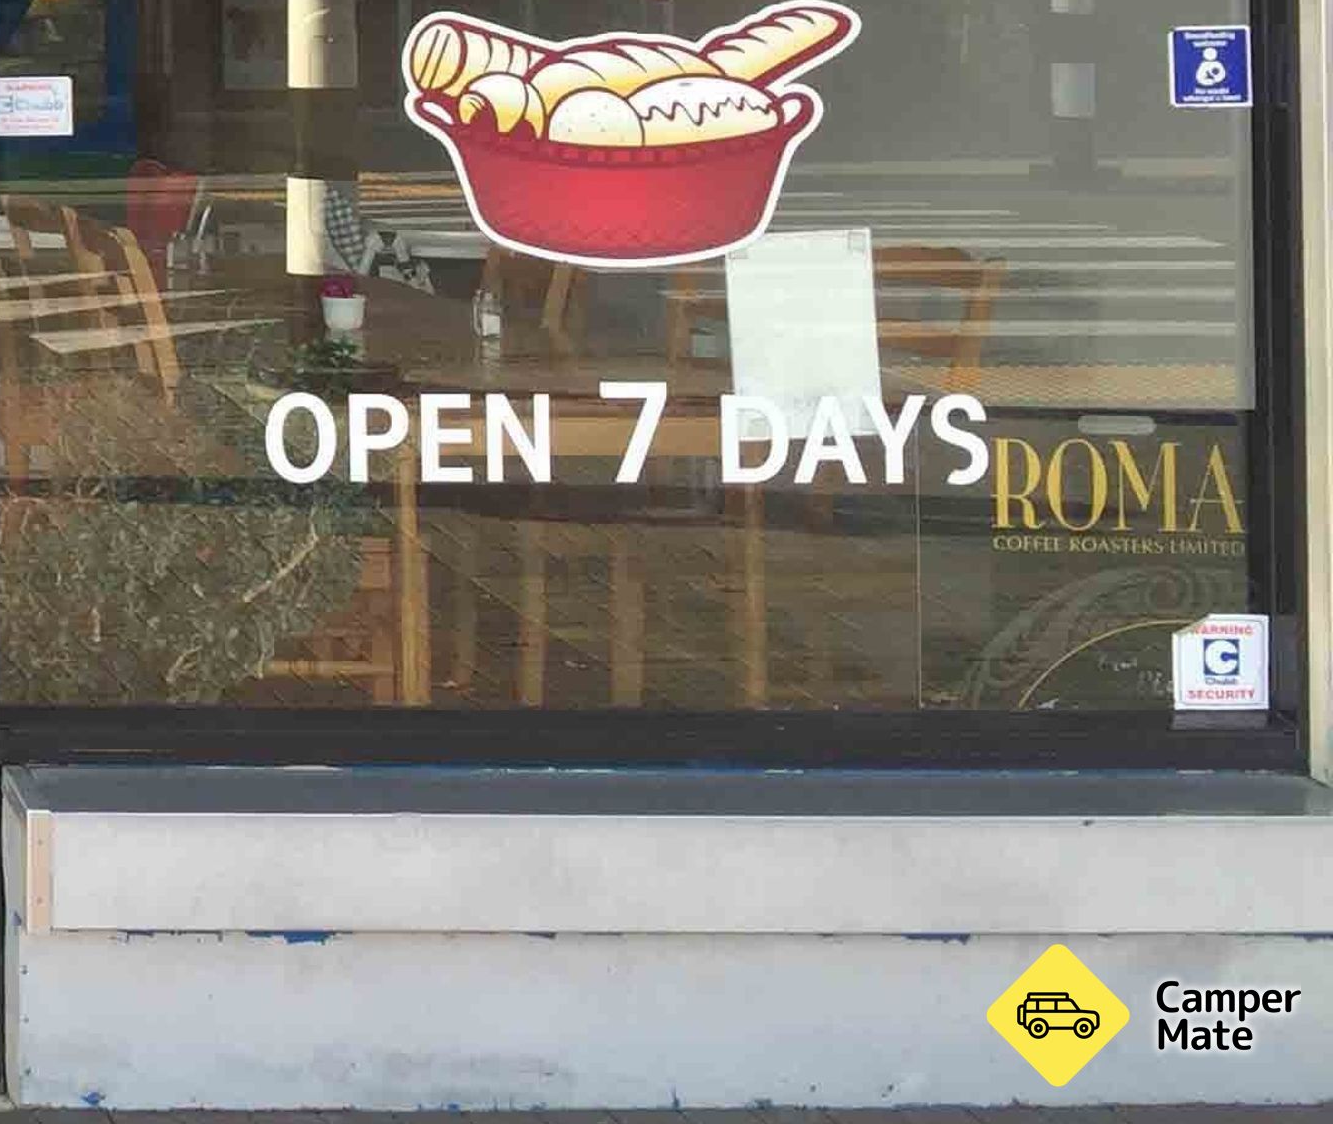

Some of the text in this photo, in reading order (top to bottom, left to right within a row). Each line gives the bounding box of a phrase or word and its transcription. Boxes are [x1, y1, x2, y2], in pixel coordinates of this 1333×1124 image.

[264, 382, 990, 485] OPEN 7 DAYS
[991, 437, 1245, 534] ROMA
[993, 535, 1060, 552] COFFEE
[1069, 535, 1166, 554] ROASTERS
[1187, 689, 1255, 701] SECURITY
